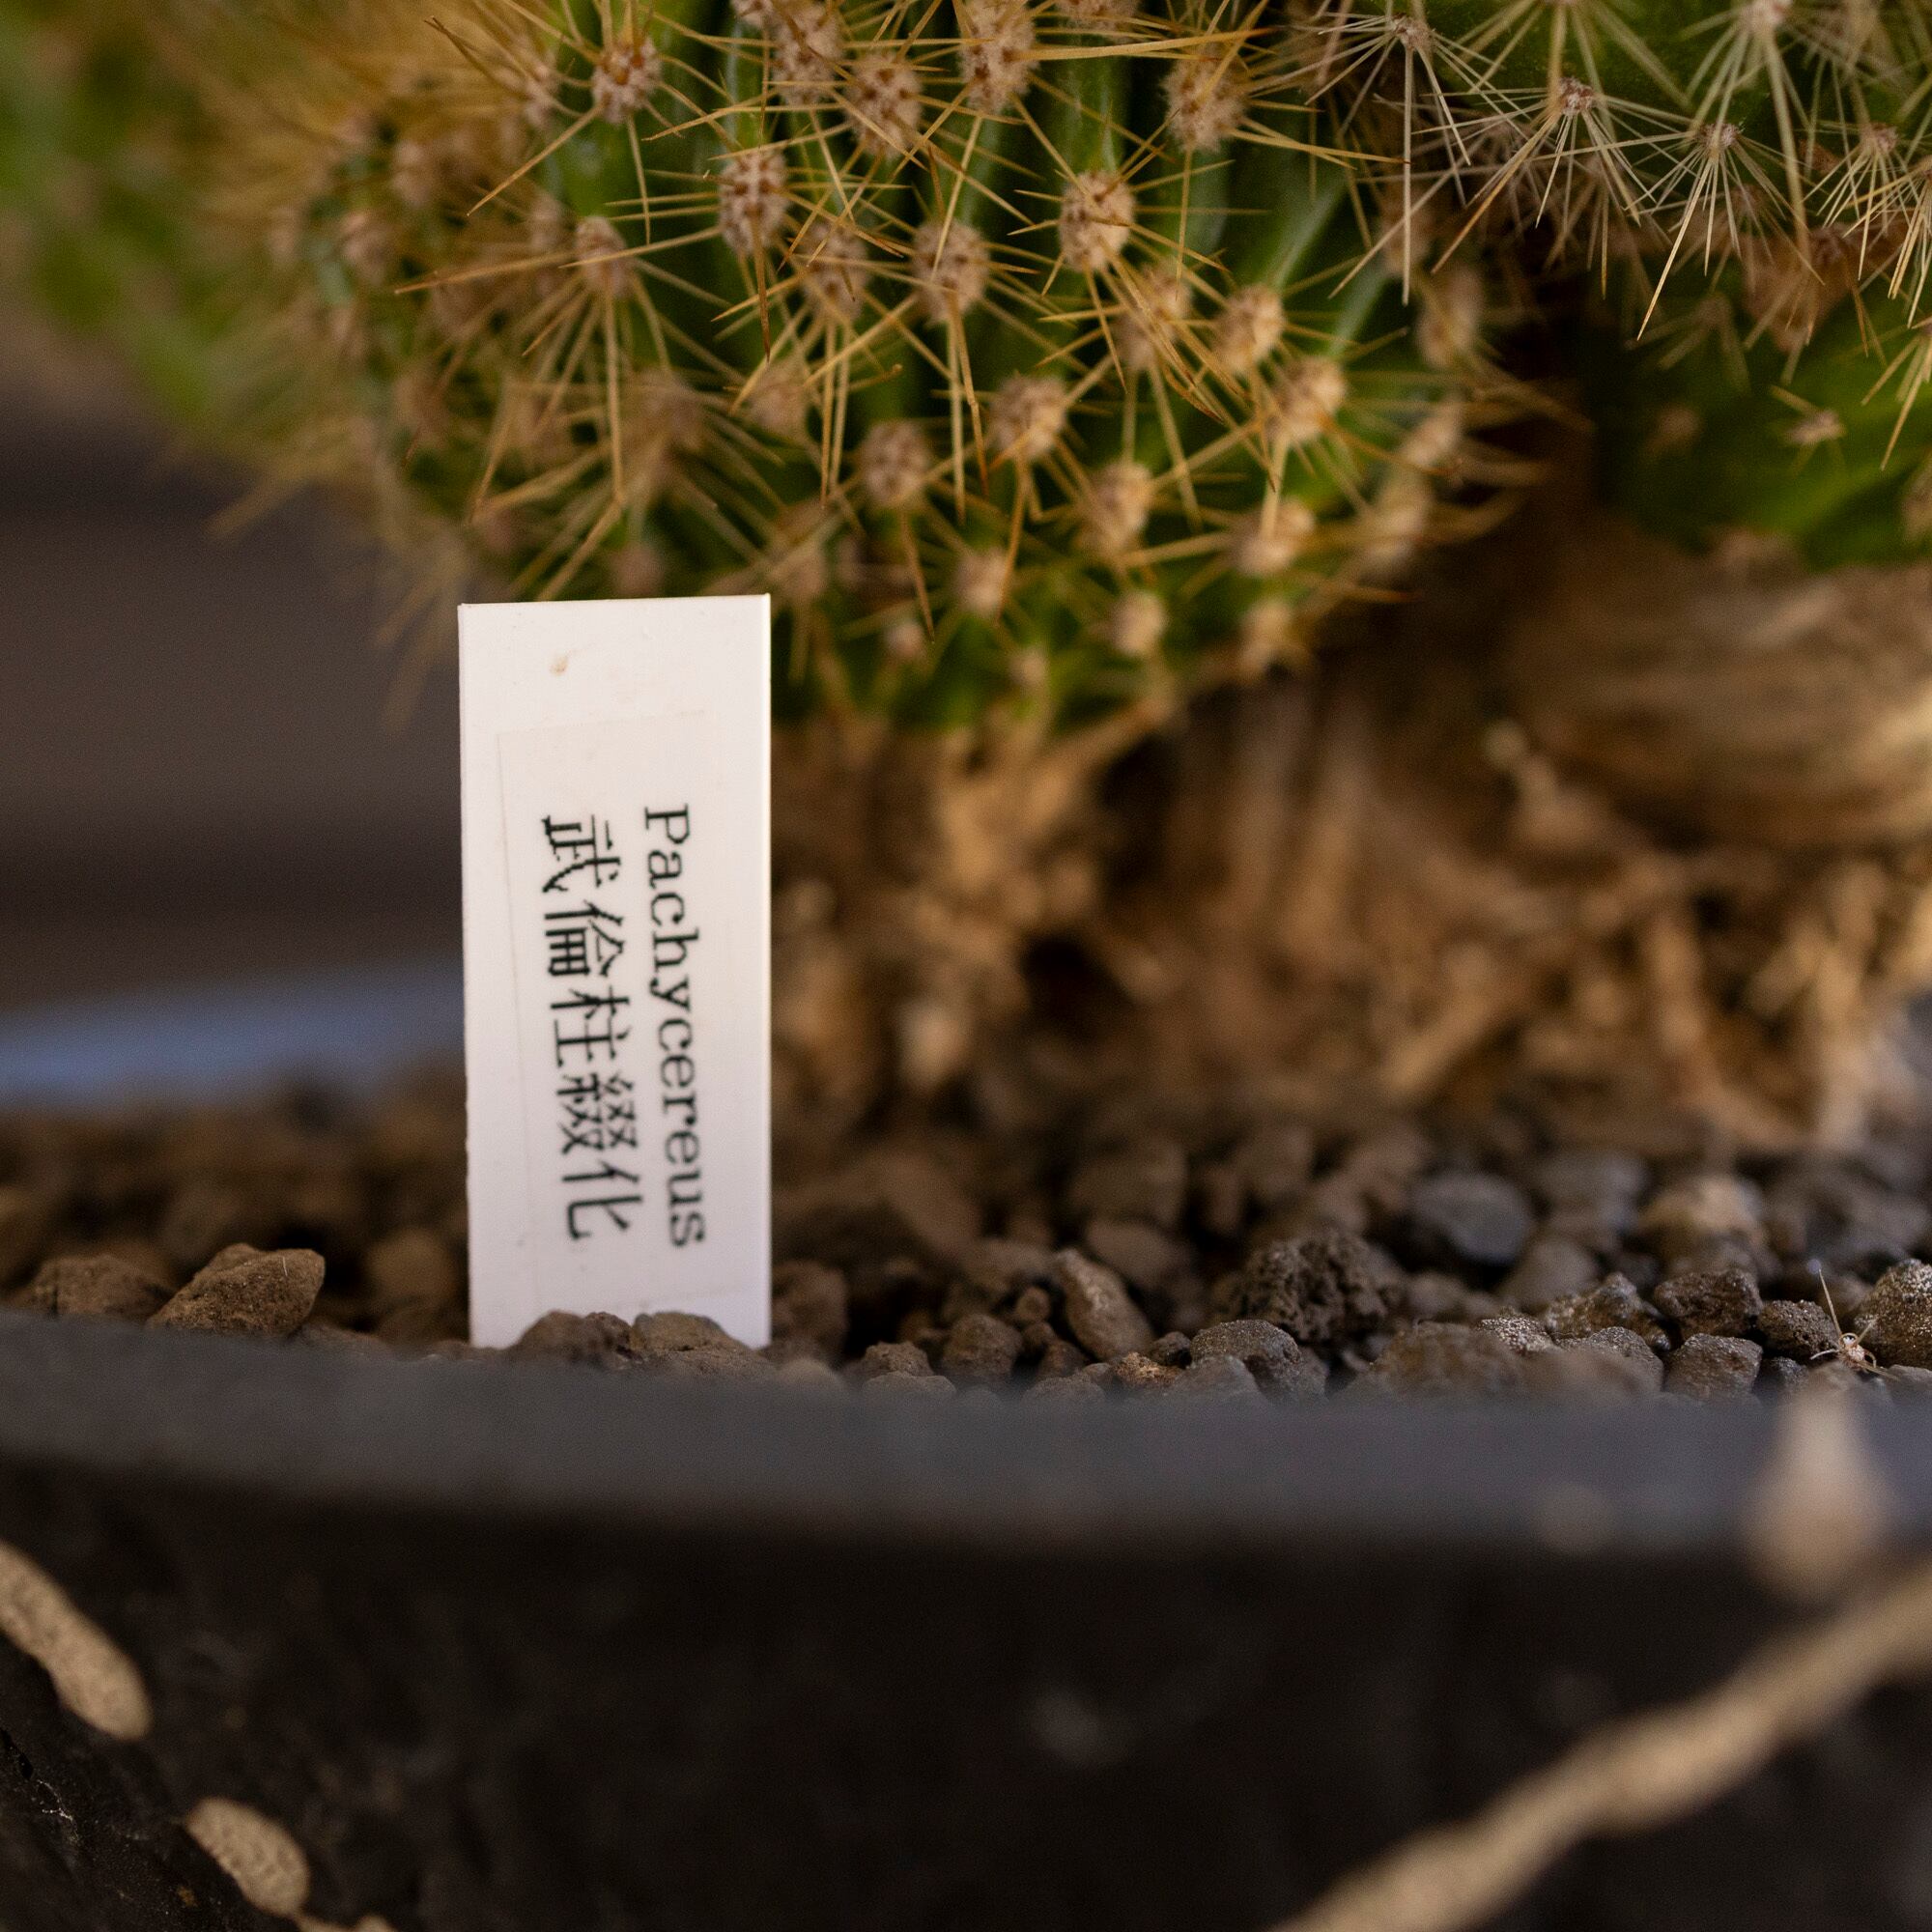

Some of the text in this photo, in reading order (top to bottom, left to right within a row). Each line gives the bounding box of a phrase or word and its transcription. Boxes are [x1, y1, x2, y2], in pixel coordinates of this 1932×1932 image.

[541, 814, 644, 1242] 武倫柱綴化
[642, 804, 705, 1248] Pachycereus
